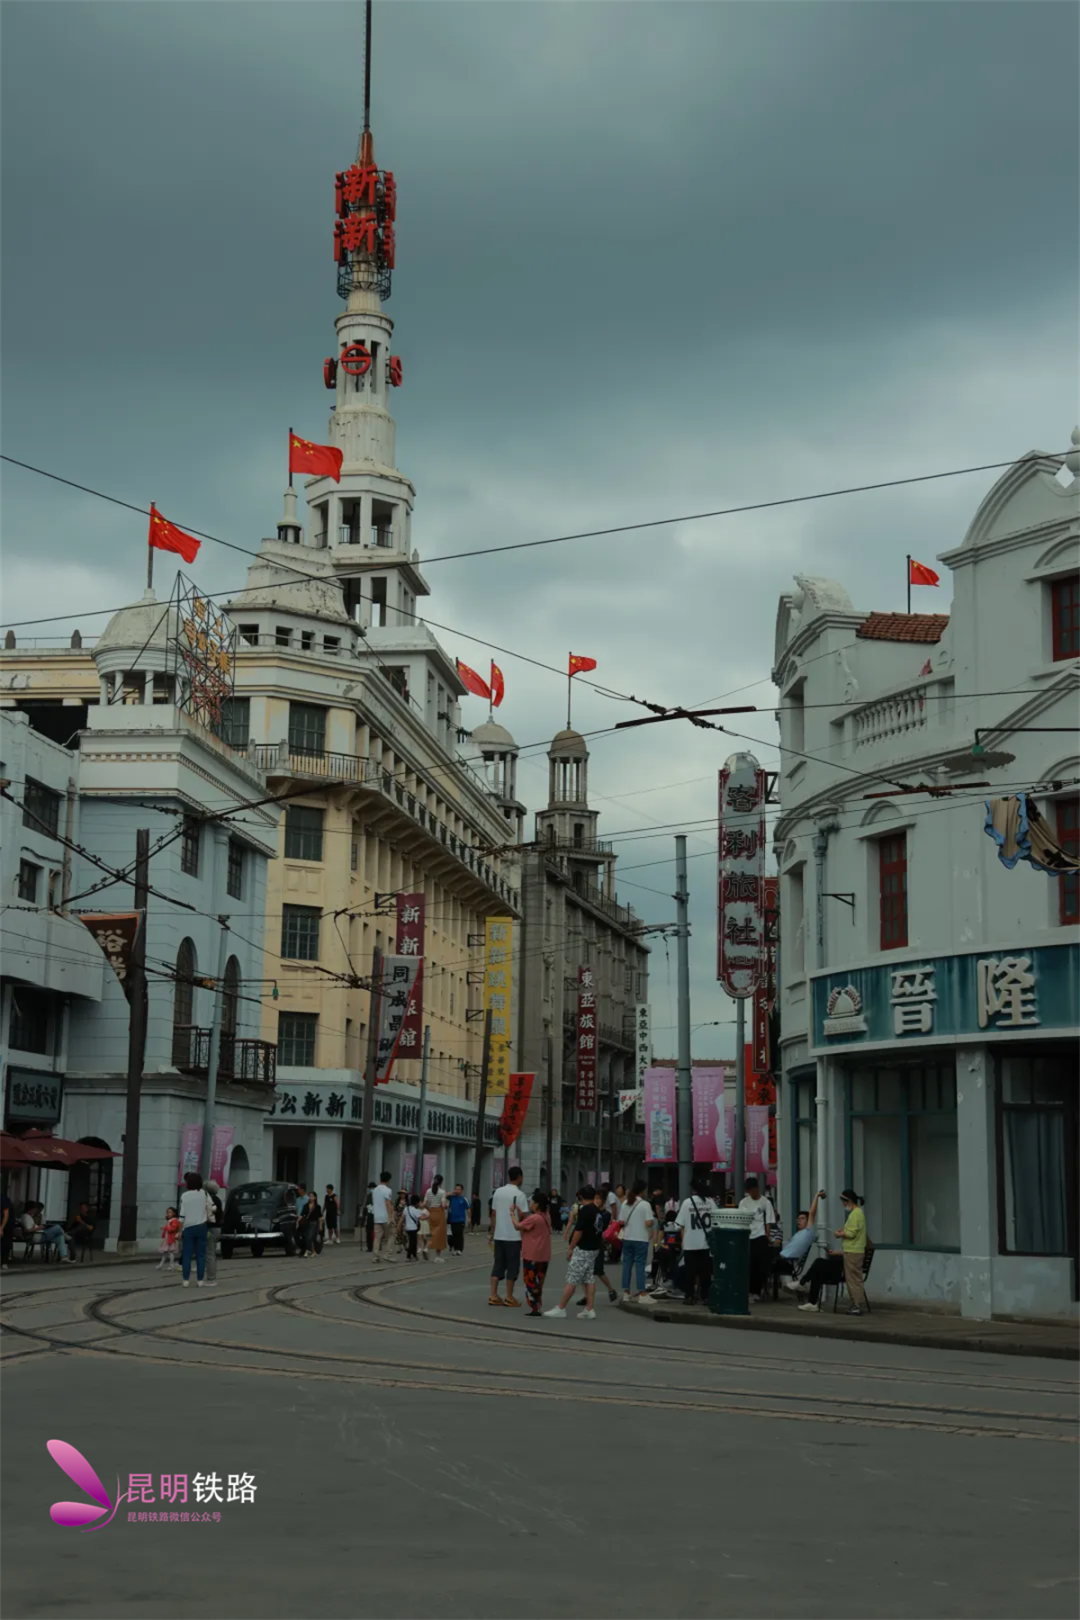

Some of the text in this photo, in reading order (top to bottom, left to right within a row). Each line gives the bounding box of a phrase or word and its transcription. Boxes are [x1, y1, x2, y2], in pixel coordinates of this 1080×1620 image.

[726, 784, 757, 945] 客利旅社
[579, 971, 596, 1050] 東亞旅館
[889, 957, 1041, 1035] 晉隆
